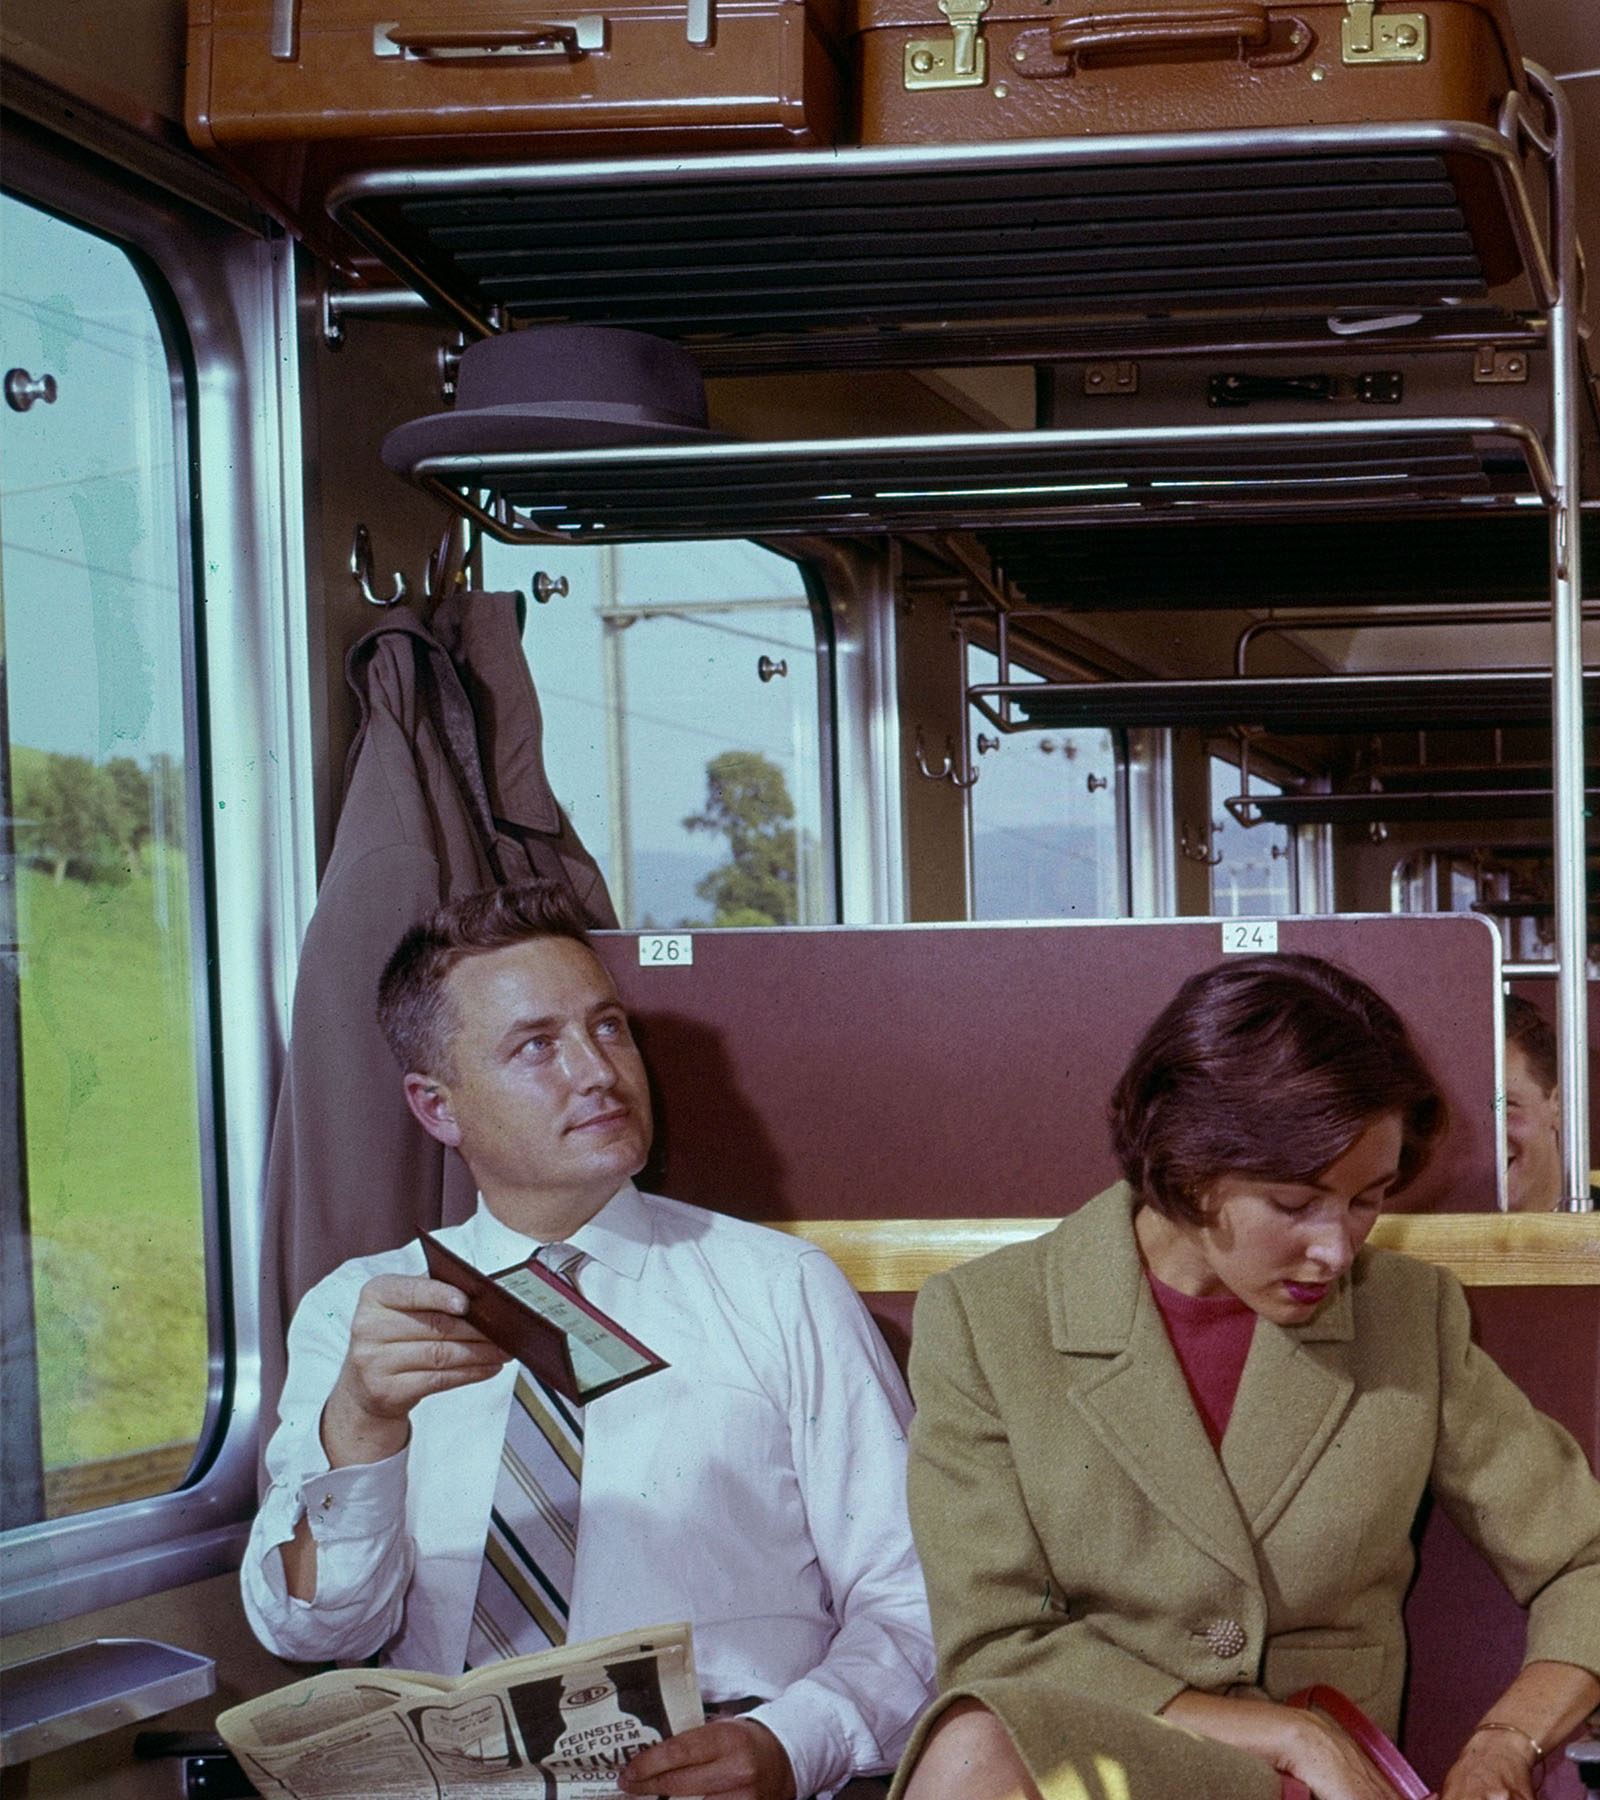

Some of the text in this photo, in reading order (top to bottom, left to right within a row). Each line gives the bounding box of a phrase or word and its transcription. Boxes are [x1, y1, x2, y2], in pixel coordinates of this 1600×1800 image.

[1235, 926, 1263, 948] 24
[652, 939, 679, 961] 26
[559, 1718, 637, 1749] FEINSTES
[562, 1729, 641, 1758] REFORM
